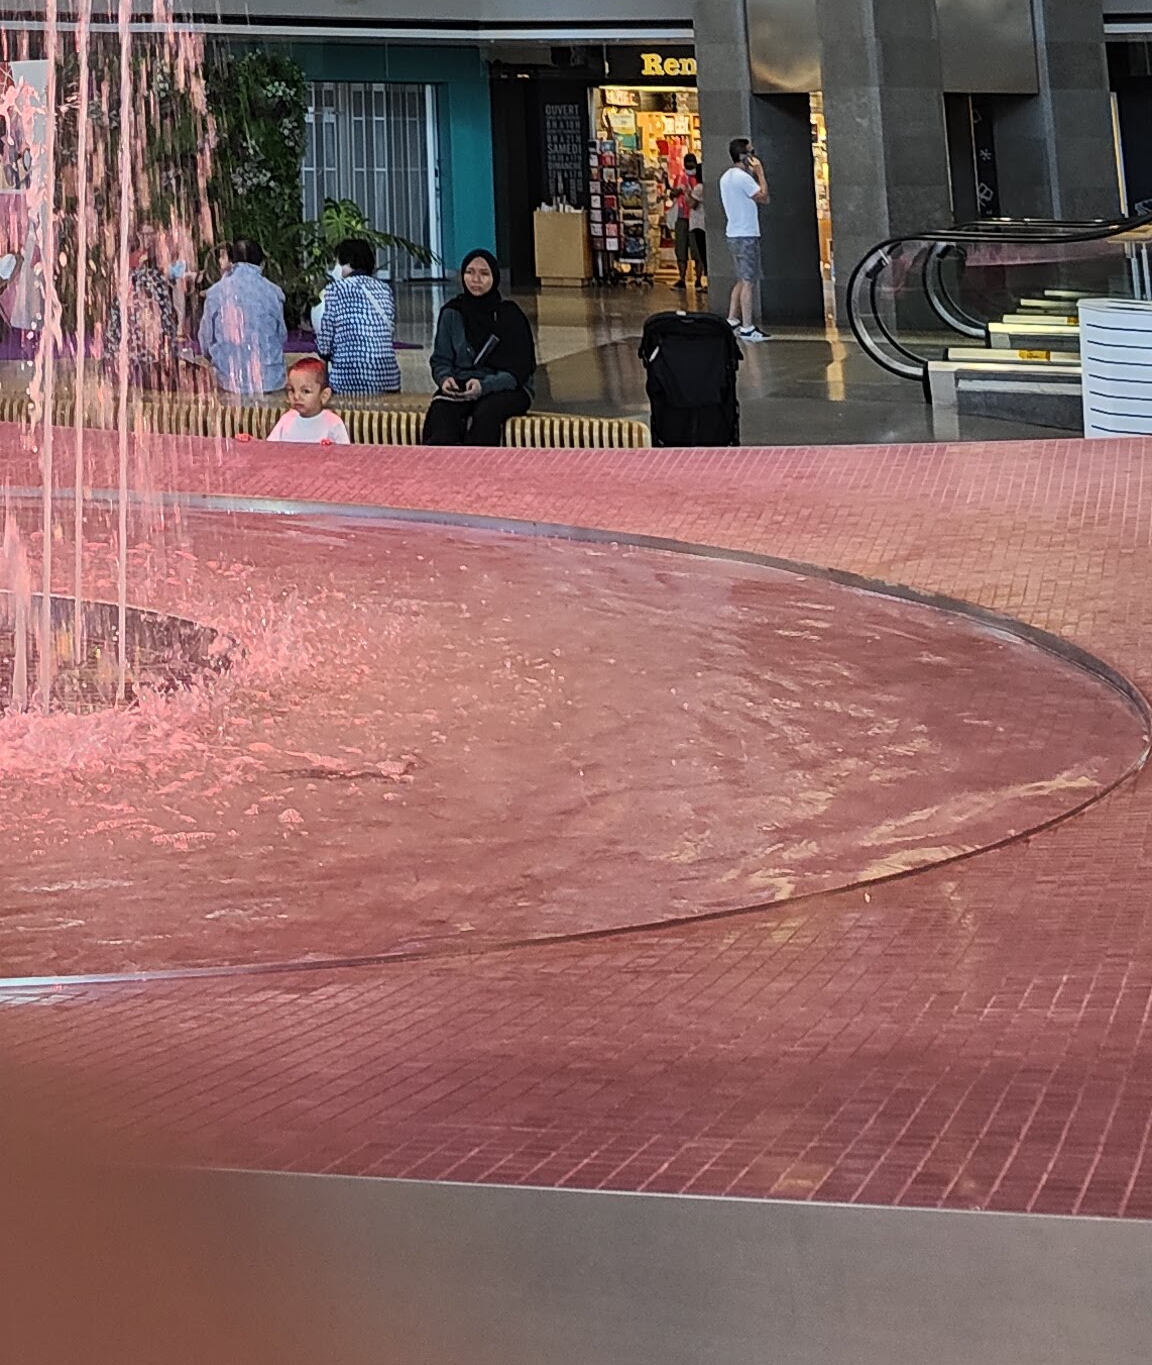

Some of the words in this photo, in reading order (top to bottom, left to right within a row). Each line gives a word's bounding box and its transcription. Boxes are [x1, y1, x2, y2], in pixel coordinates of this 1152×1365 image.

[641, 53, 697, 76] Ren
[545, 104, 579, 115] OUVERT
[547, 143, 582, 155] SAMEDI
